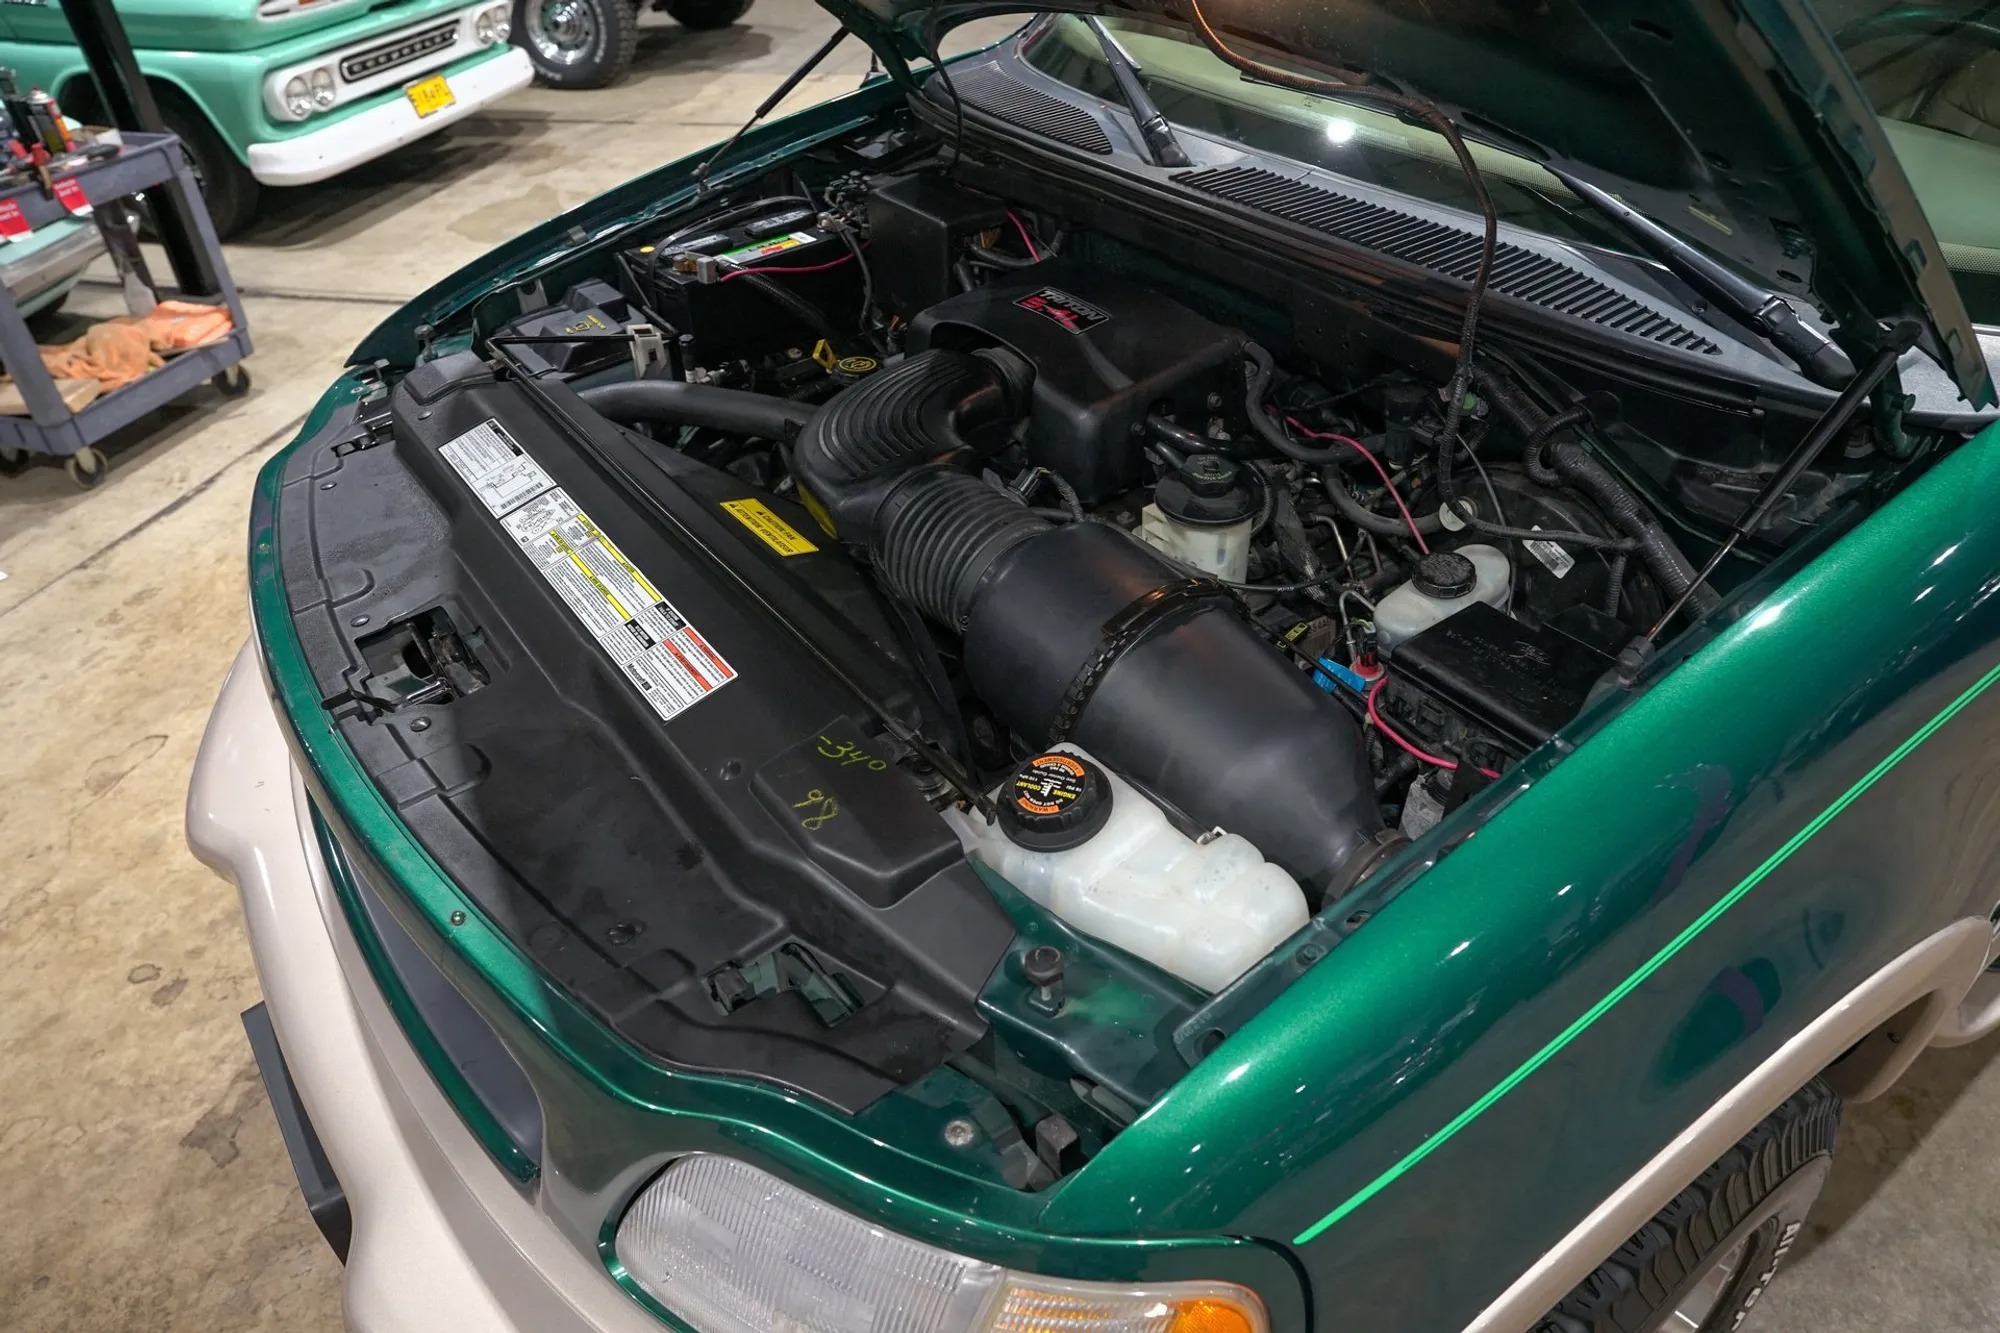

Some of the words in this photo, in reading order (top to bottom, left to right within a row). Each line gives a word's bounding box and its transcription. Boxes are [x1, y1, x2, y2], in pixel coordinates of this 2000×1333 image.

[1020, 296, 1080, 330] 5.4L
[1039, 290, 1103, 321] TRITON
[761, 515, 787, 531] CAUTION
[782, 532, 797, 540] FAN
[1032, 769, 1047, 777] Guide
[1048, 773, 1065, 781] Owner
[1016, 781, 1041, 790] COOLANT
[1052, 789, 1076, 799] ENGINE
[792, 789, 838, 831] 98
